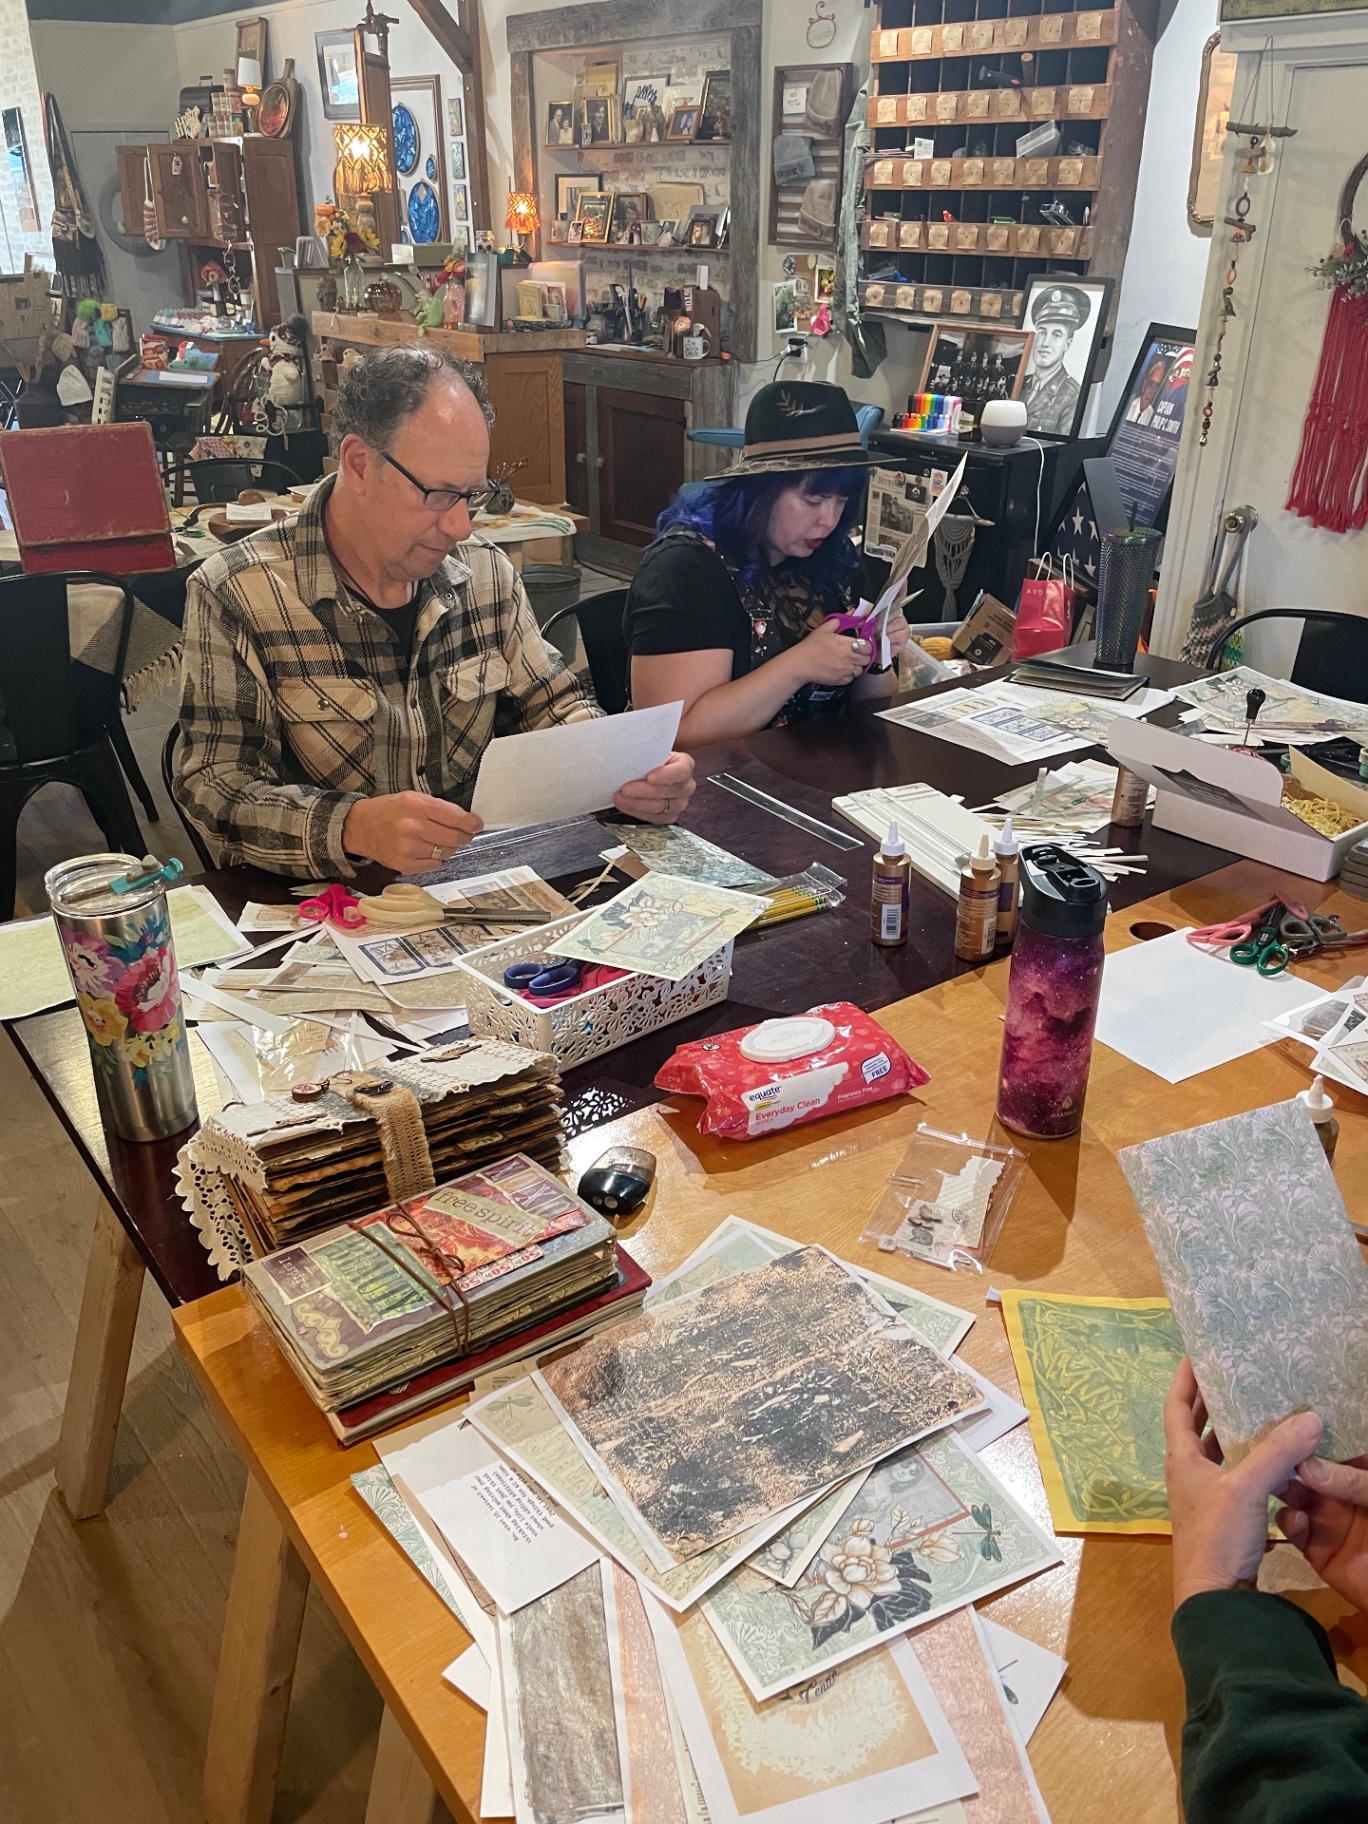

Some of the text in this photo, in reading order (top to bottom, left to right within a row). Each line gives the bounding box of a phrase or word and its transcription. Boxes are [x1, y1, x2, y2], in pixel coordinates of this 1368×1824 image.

[871, 1067, 888, 1079] FREE
[749, 1086, 782, 1102] equate
[837, 1089, 861, 1100] Fragrance
[861, 1087, 873, 1095] Free
[755, 1103, 795, 1122] Everyday
[797, 1097, 821, 1110] Clean
[755, 1117, 775, 1127] WIPES
[435, 1190, 536, 1238] free spirit
[324, 1234, 424, 1316] BEAUTY
[483, 1473, 497, 1488] think
[492, 1471, 517, 1498] additional
[495, 1488, 508, 1500] just
[519, 1489, 527, 1498] One
[475, 1475, 532, 1544] thinking about solving your
[477, 1492, 495, 1512] instead
[506, 1499, 515, 1509] you
[515, 1497, 531, 1515] adding
[525, 1522, 538, 1537] whole
[530, 1515, 544, 1530] about
[541, 1516, 555, 1529] good
